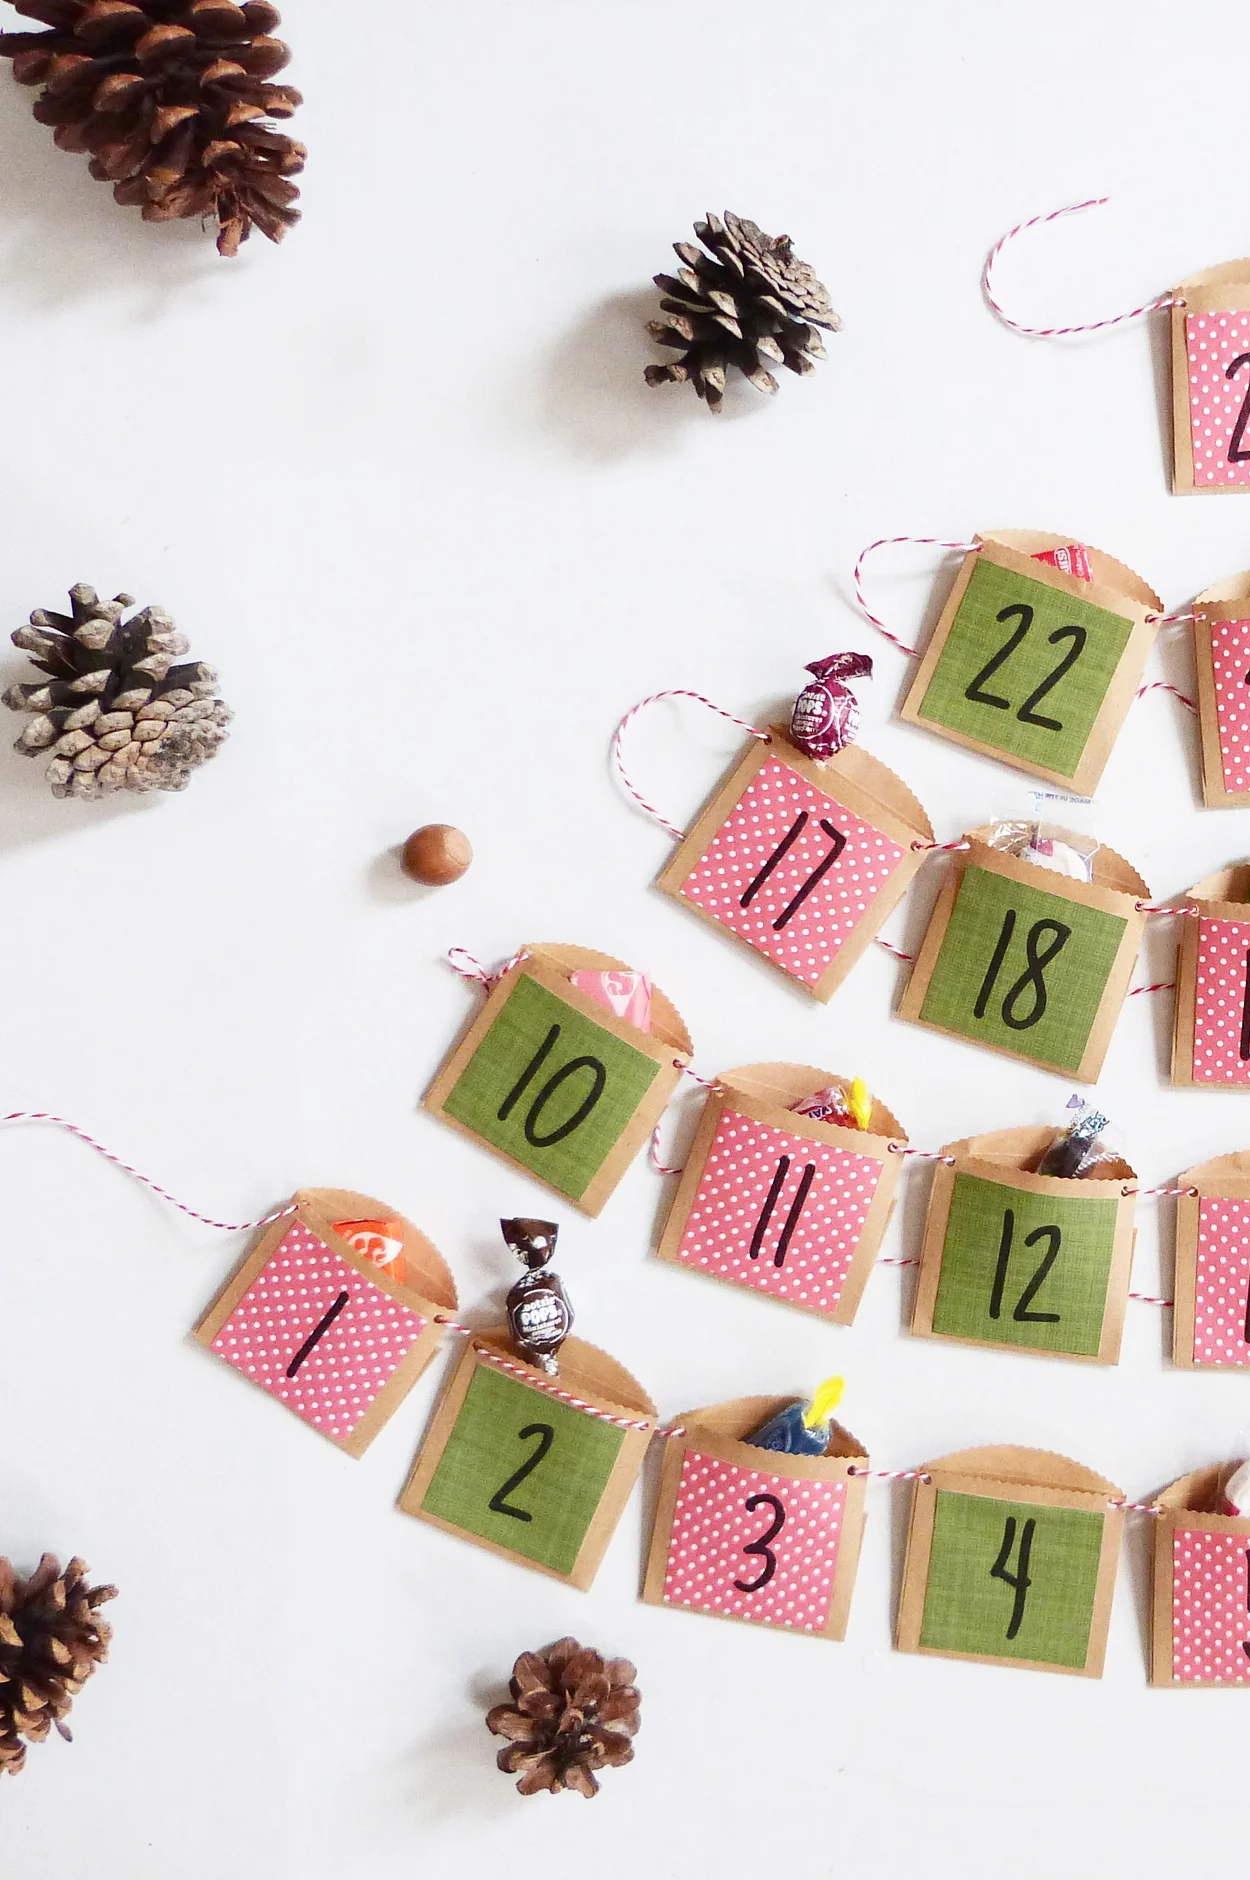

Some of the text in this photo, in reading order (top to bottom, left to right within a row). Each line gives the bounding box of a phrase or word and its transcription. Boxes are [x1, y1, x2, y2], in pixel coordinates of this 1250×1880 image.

[964, 603, 1087, 732] 22
[739, 810, 847, 932] 17
[973, 909, 1072, 1031] 18
[496, 1023, 607, 1148] 10
[748, 1154, 816, 1268] 11
[988, 1207, 1062, 1324] 12
[286, 1290, 350, 1379] 1
[521, 1304, 558, 1326] POPS
[488, 1422, 556, 1523] 2
[733, 1493, 786, 1593] 3
[989, 1515, 1037, 1640] 4
